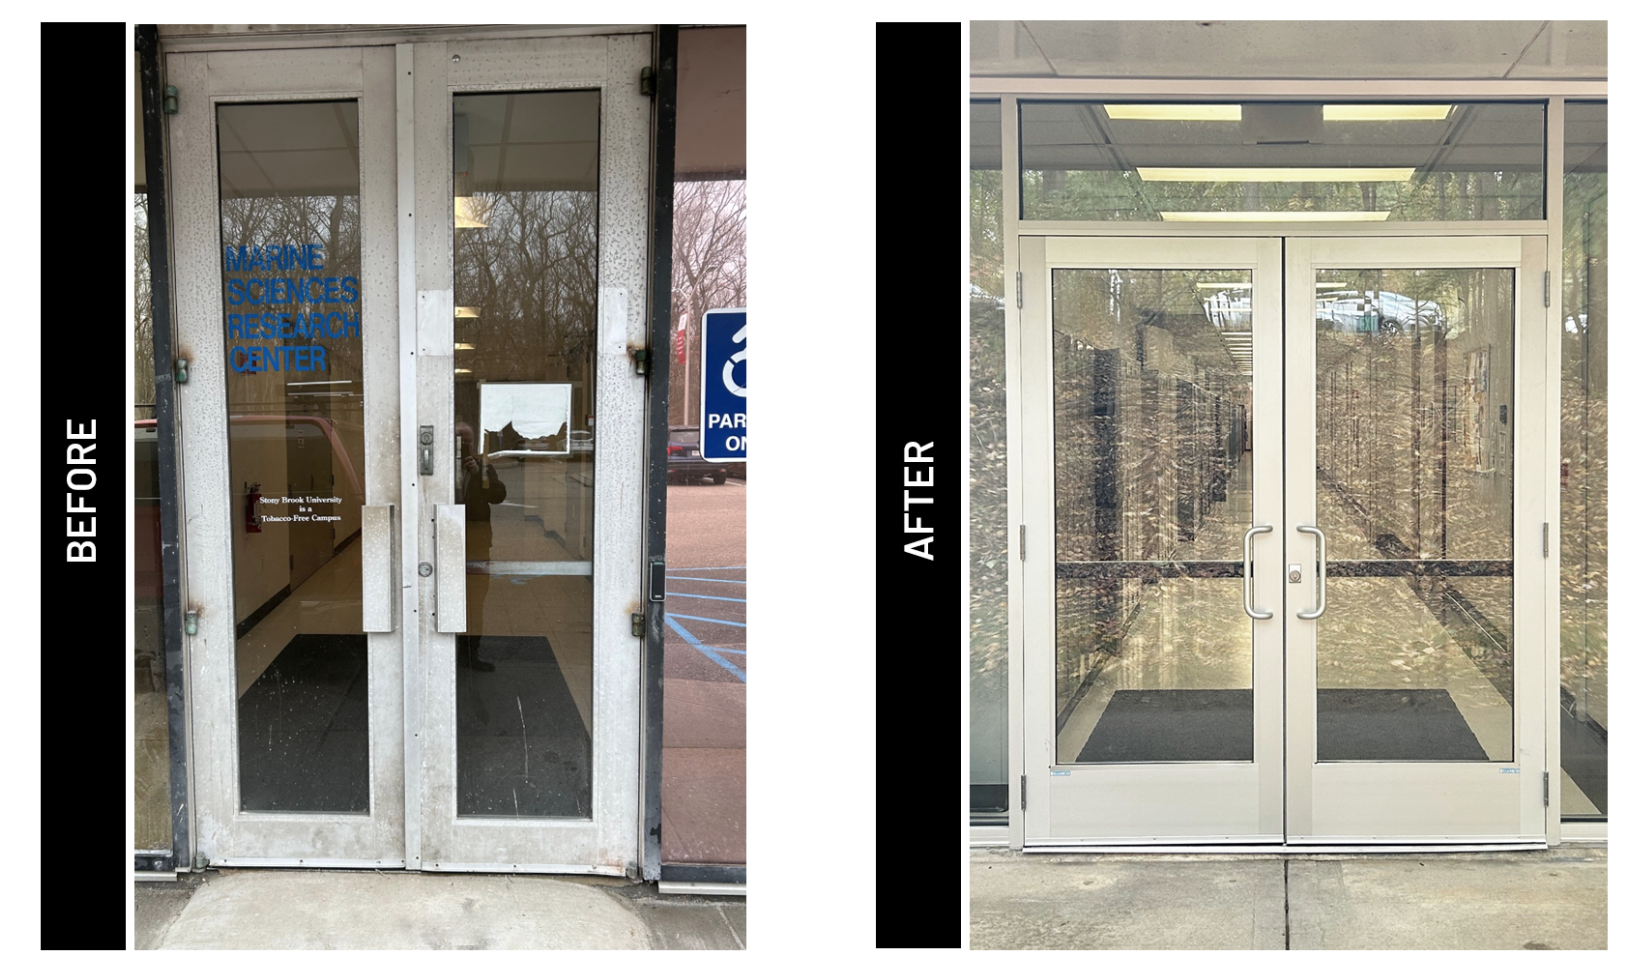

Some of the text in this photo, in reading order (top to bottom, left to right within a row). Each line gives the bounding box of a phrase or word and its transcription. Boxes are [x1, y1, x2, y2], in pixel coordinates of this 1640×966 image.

[226, 244, 324, 272] MARINE
[228, 276, 359, 306] SCIENCES
[228, 312, 360, 340] RESEARCH
[230, 346, 326, 373] CENTER
[709, 413, 746, 428] PAR
[259, 496, 342, 505] Stony Brook University
[311, 514, 341, 522] Campus
